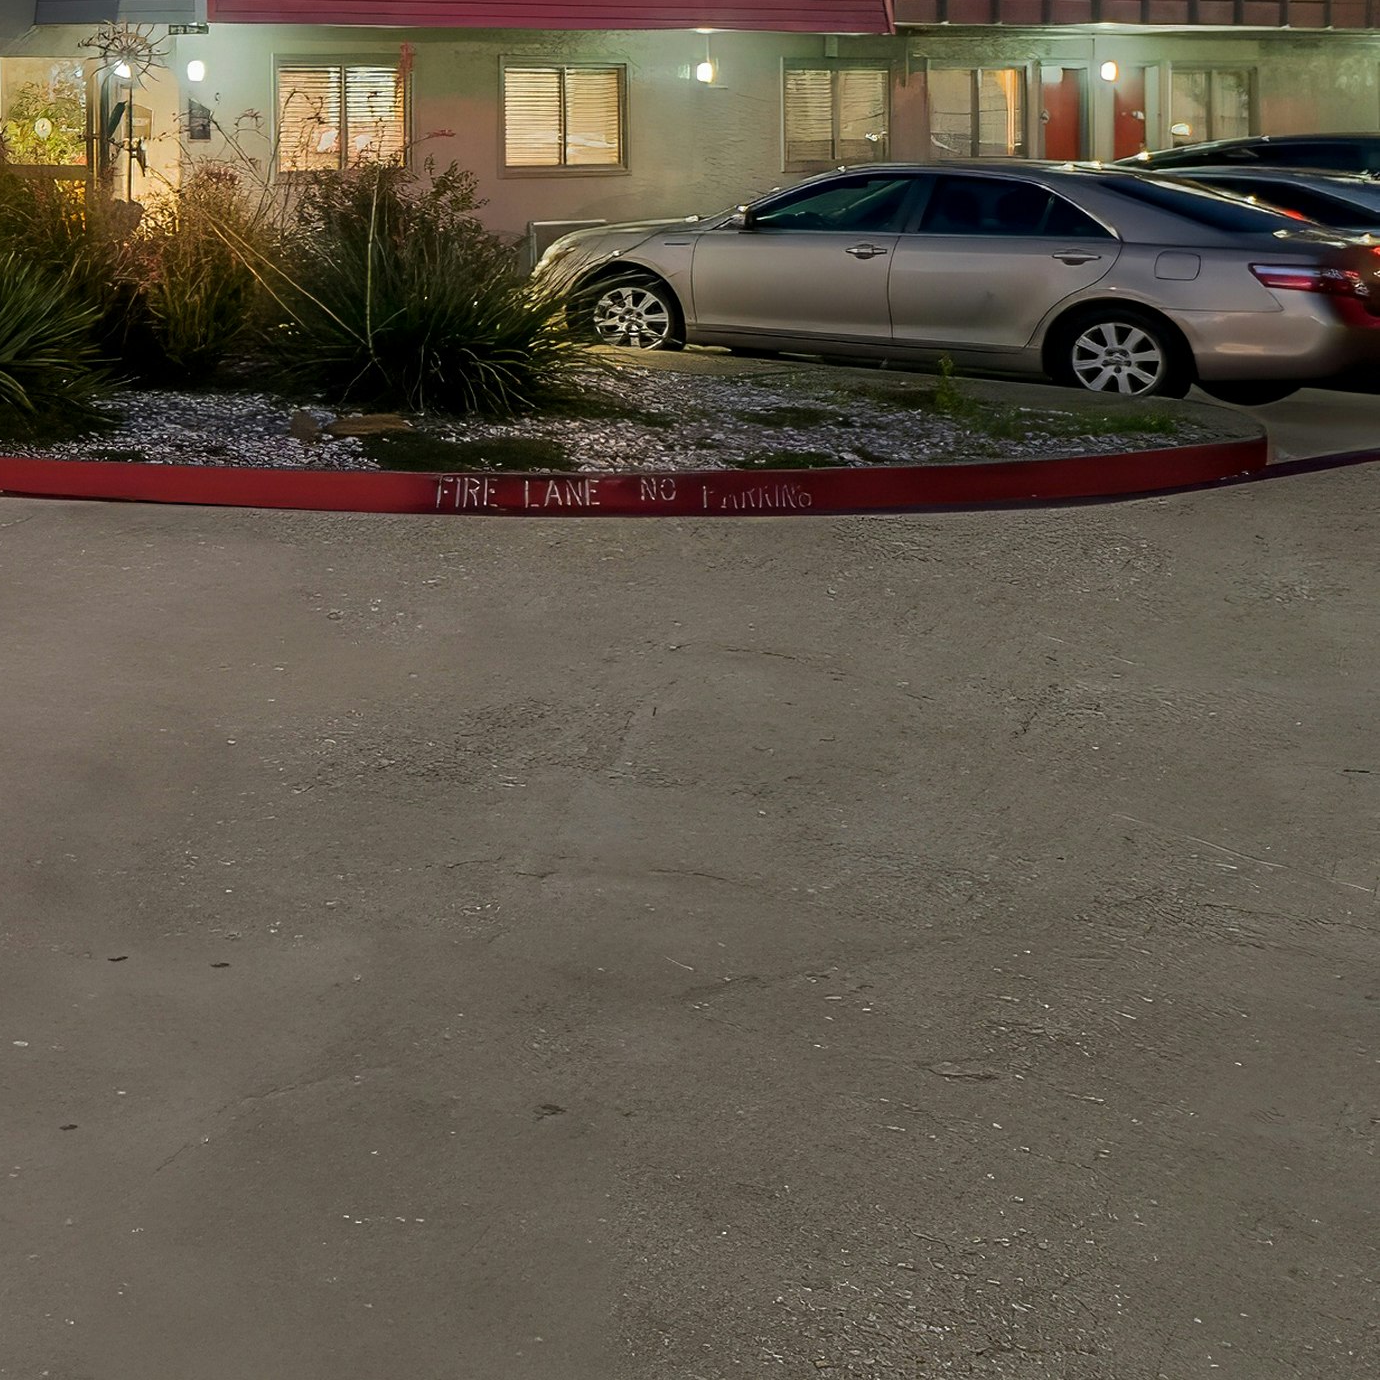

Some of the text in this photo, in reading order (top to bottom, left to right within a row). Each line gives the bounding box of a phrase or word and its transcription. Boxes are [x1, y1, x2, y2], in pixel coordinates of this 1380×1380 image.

[436, 477, 499, 508] FIRE
[525, 479, 601, 508] LANE
[640, 478, 677, 501] NO
